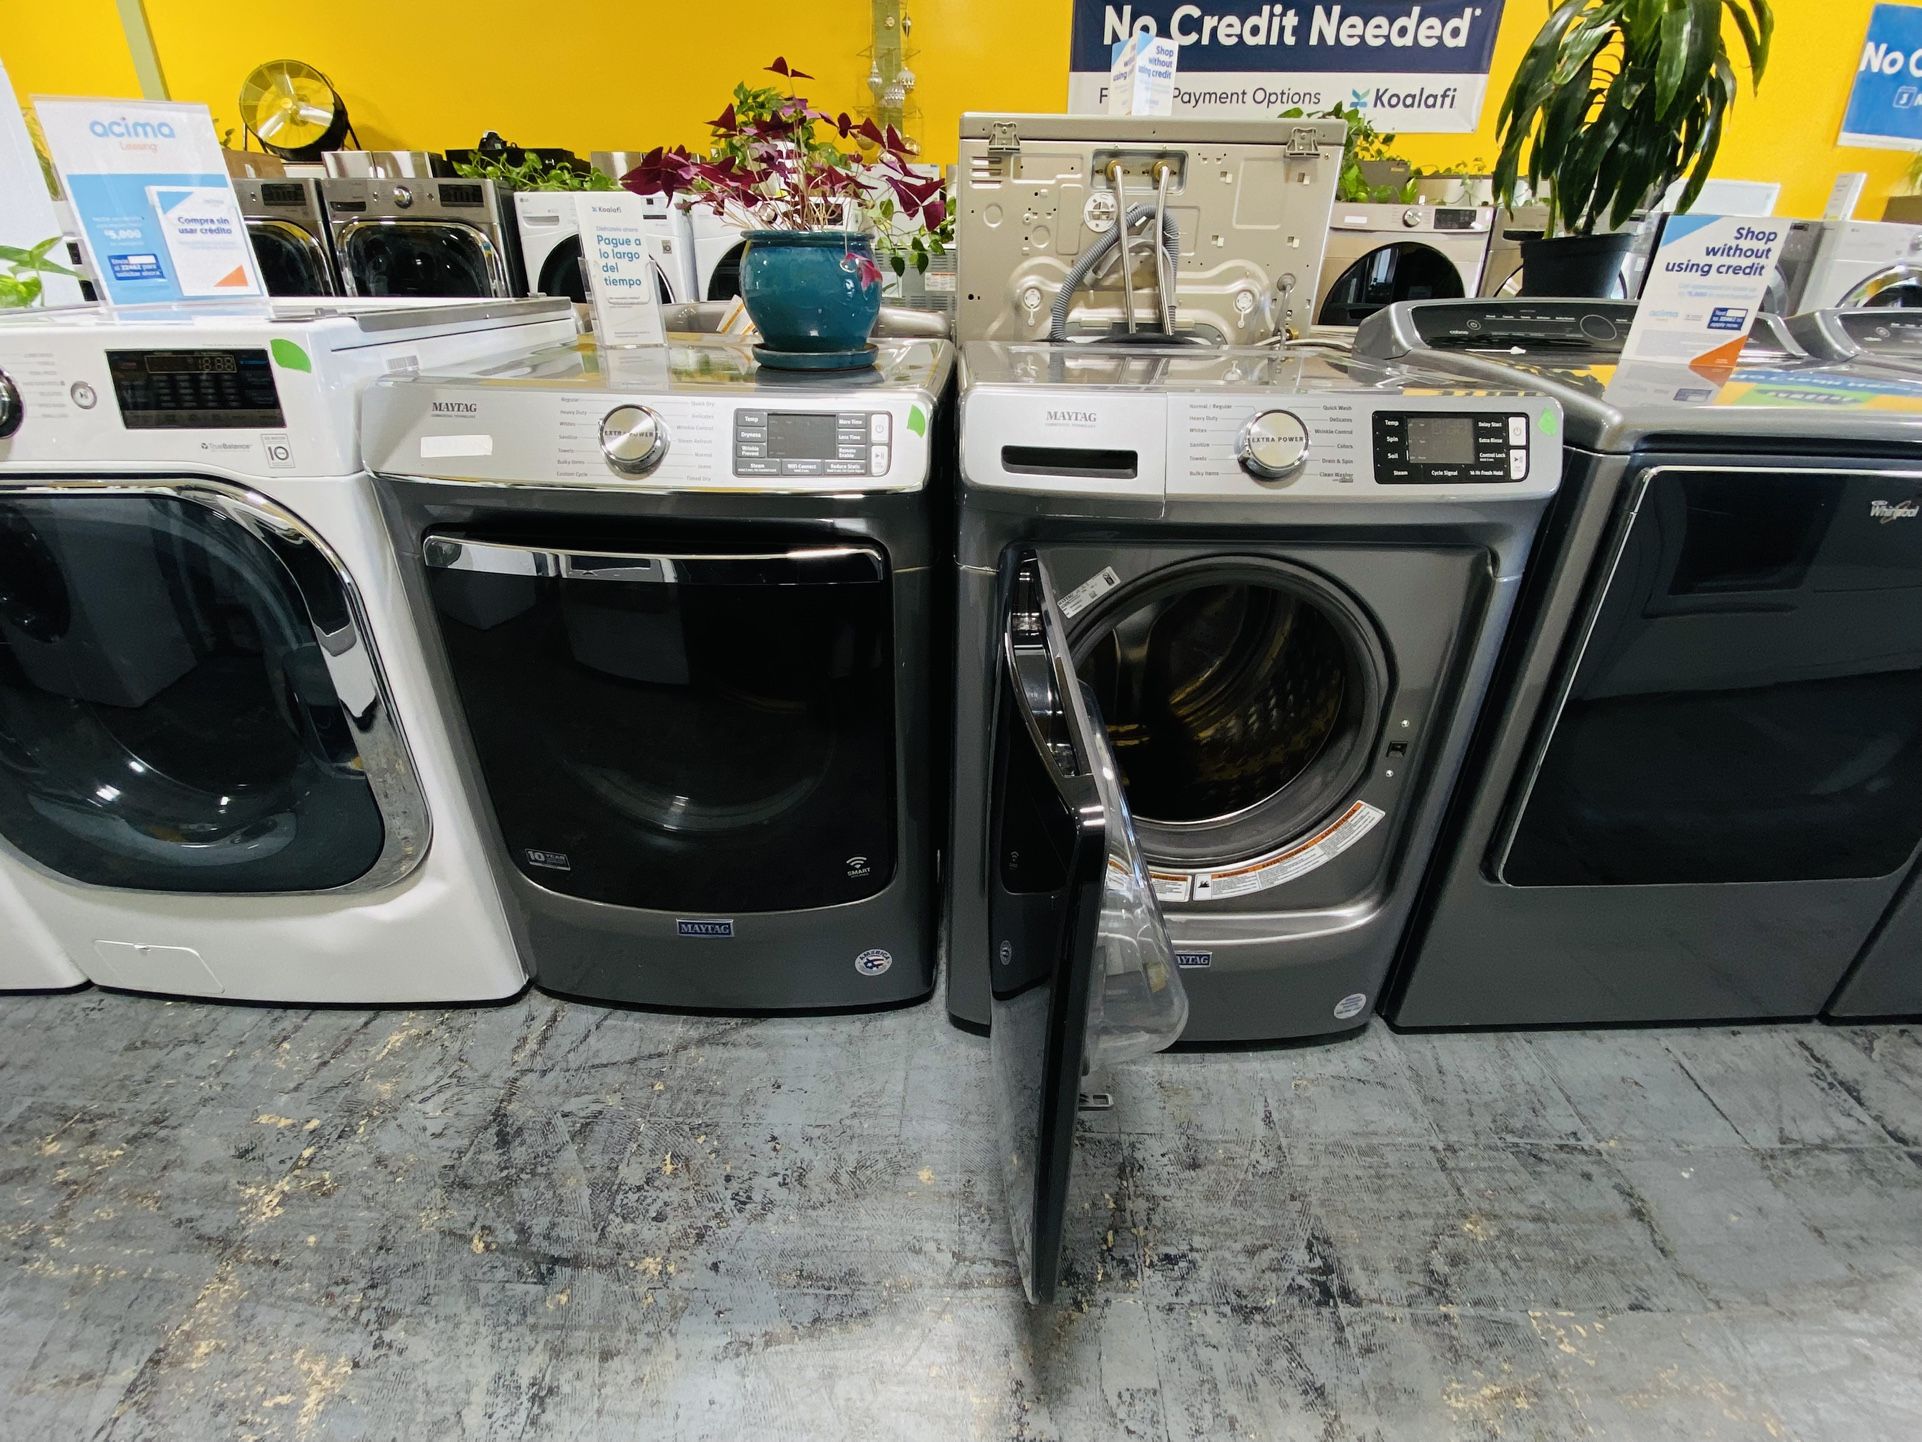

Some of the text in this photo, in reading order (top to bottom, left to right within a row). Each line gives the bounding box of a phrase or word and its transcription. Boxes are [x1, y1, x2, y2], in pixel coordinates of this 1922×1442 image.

[1103, 5, 1157, 46] No
[1170, 5, 1299, 46] Credit
[1156, 45, 1174, 58] Shop
[1149, 57, 1173, 68] without
[1859, 42, 1904, 74] No
[1152, 68, 1172, 79] credit
[1173, 88, 1321, 108] Payment Options
[1373, 87, 1457, 109] Koalafi
[89, 116, 176, 139] acima
[178, 216, 230, 225] Compra sin
[597, 235, 631, 248] Pague
[1734, 227, 1778, 244] Shop
[599, 248, 641, 262] lo largo
[1705, 244, 1772, 259] without
[602, 263, 619, 273] del
[1665, 260, 1766, 277] using credit
[604, 277, 642, 289] tiempo
[432, 402, 477, 412] MAYTAG
[1047, 411, 1097, 422] MAYTAG
[741, 431, 761, 439] Dryness
[1870, 505, 1920, 520] Whirlpool
[528, 851, 545, 861] 10
[847, 867, 871, 877] SMART
[681, 923, 729, 934] MAYTAG
[1177, 956, 1208, 964] AYTAG
